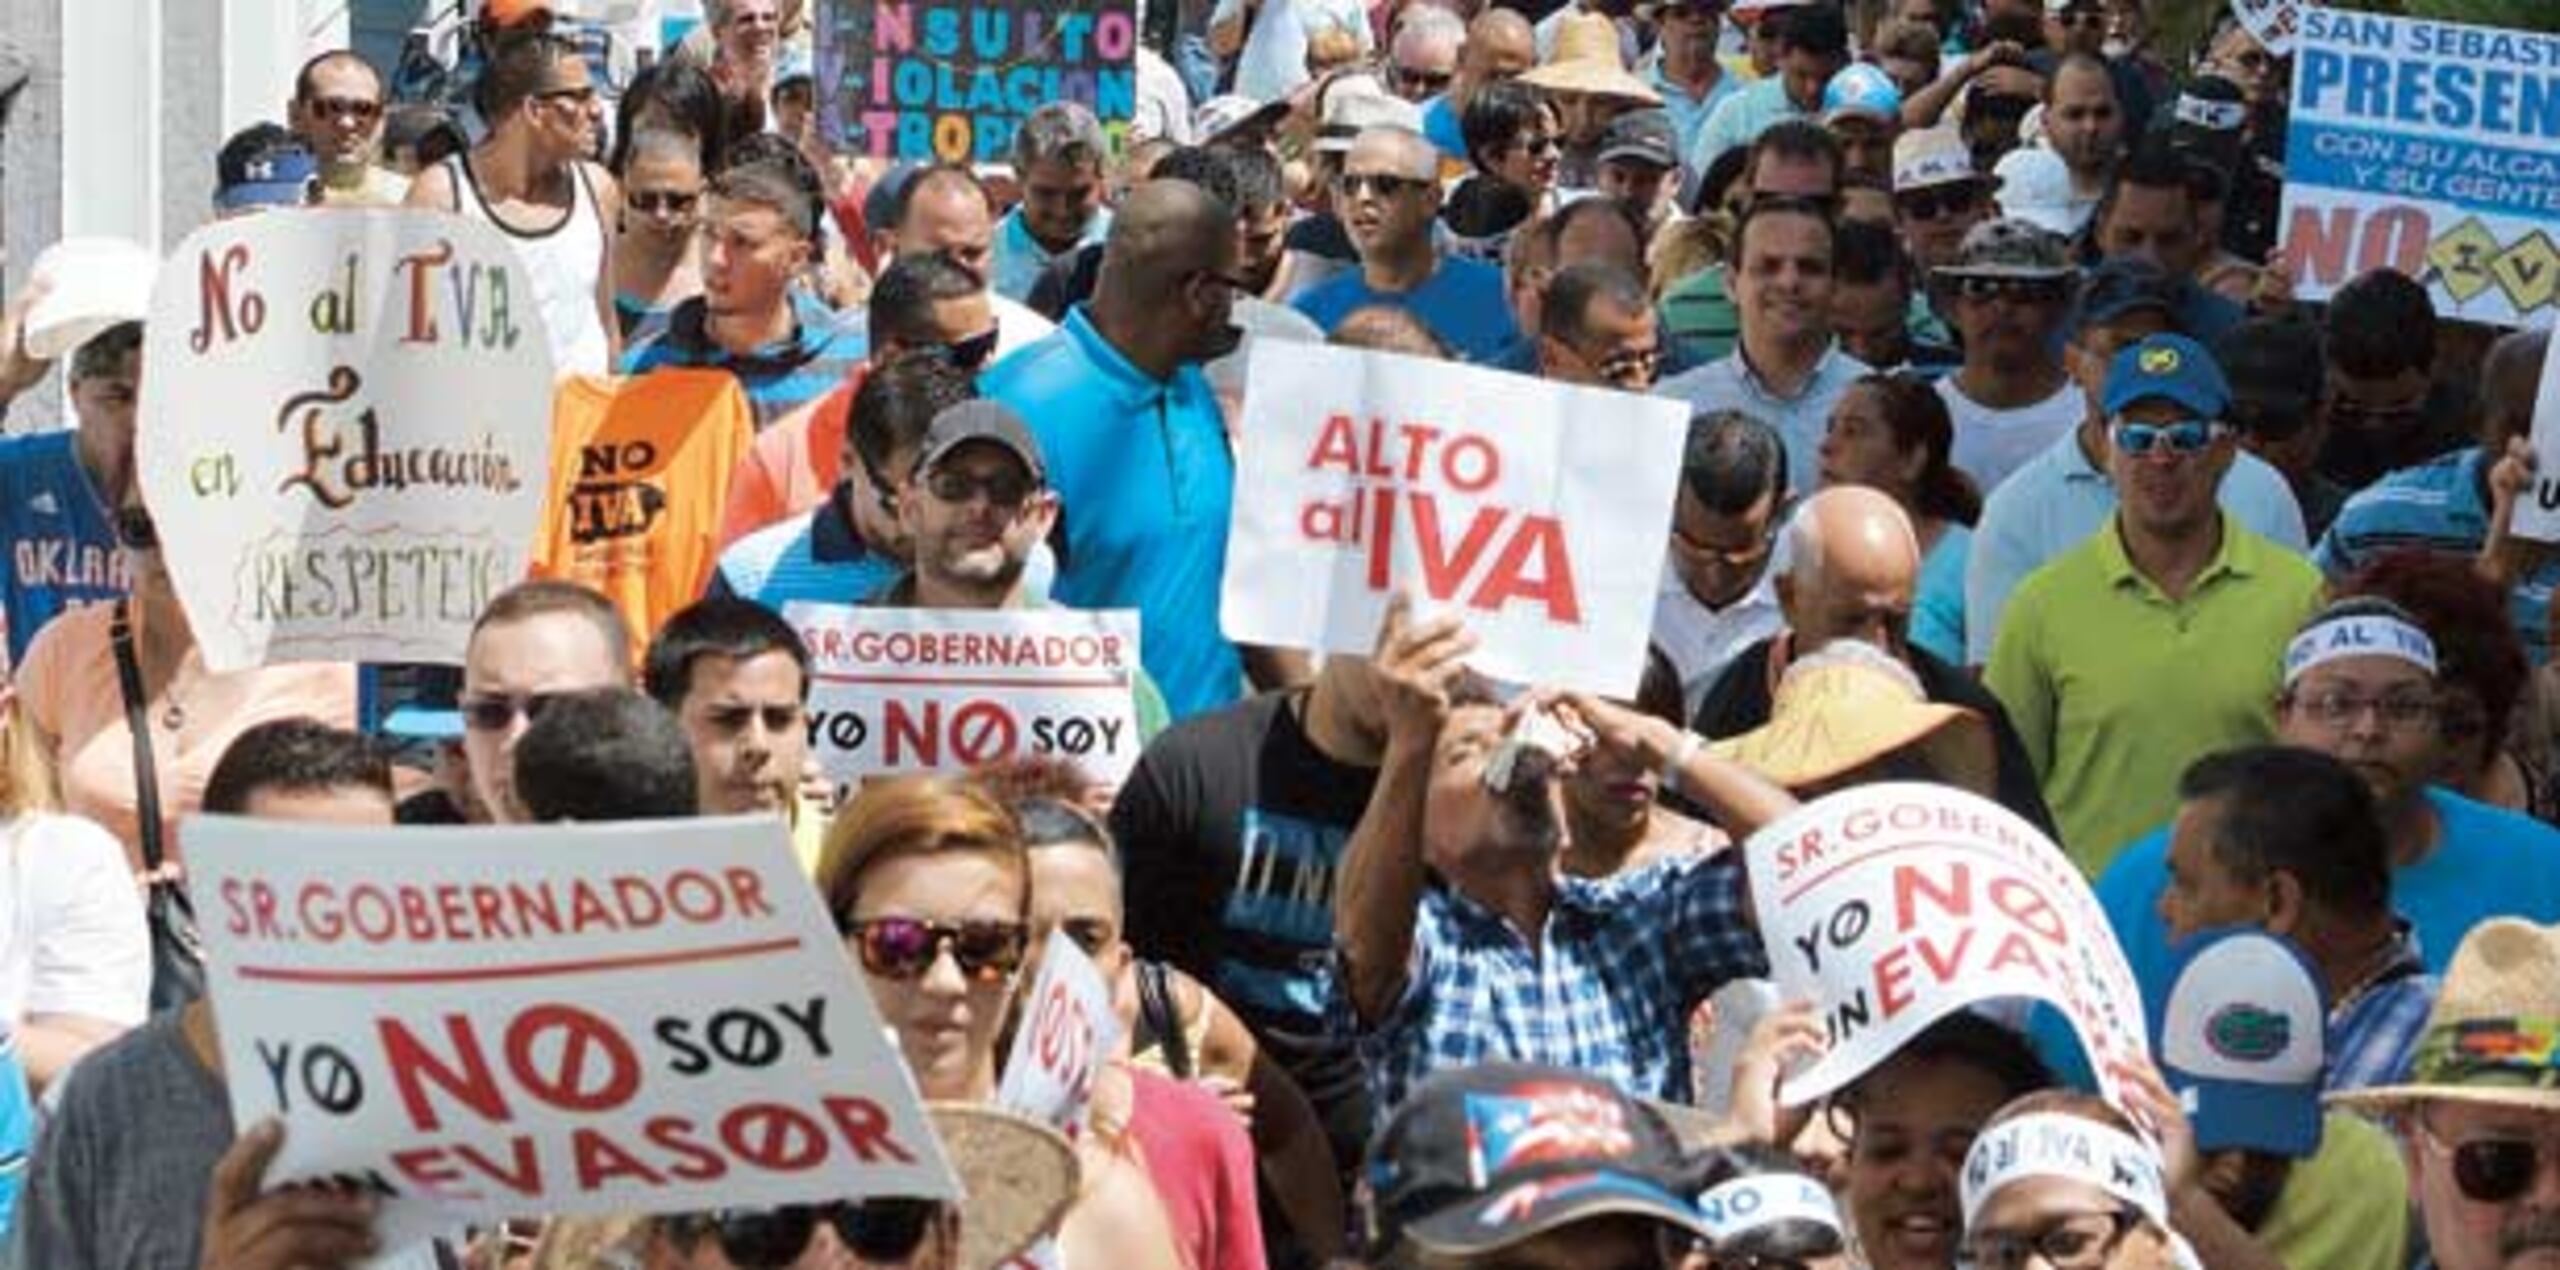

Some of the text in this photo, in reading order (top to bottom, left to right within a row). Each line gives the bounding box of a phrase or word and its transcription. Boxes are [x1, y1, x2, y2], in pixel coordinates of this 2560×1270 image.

[2305, 12, 2395, 49] SAN
[2314, 131, 2394, 160] CON
[2404, 142, 2455, 168] SU
[2354, 164, 2377, 186] Y
[2388, 167, 2436, 193] SU
[2289, 206, 2431, 284] NO
[190, 239, 521, 354] No al IVA
[190, 450, 238, 496] en
[583, 440, 656, 477] NO
[1307, 414, 1502, 493] ALTO
[1301, 486, 1582, 626] al IVA
[2330, 623, 2375, 647] AL
[805, 699, 1122, 768] YO NO SOY
[1794, 861, 2067, 975] YO NO
[257, 998, 833, 1133] YO NO SOY
[389, 1095, 919, 1198] EVASOR
